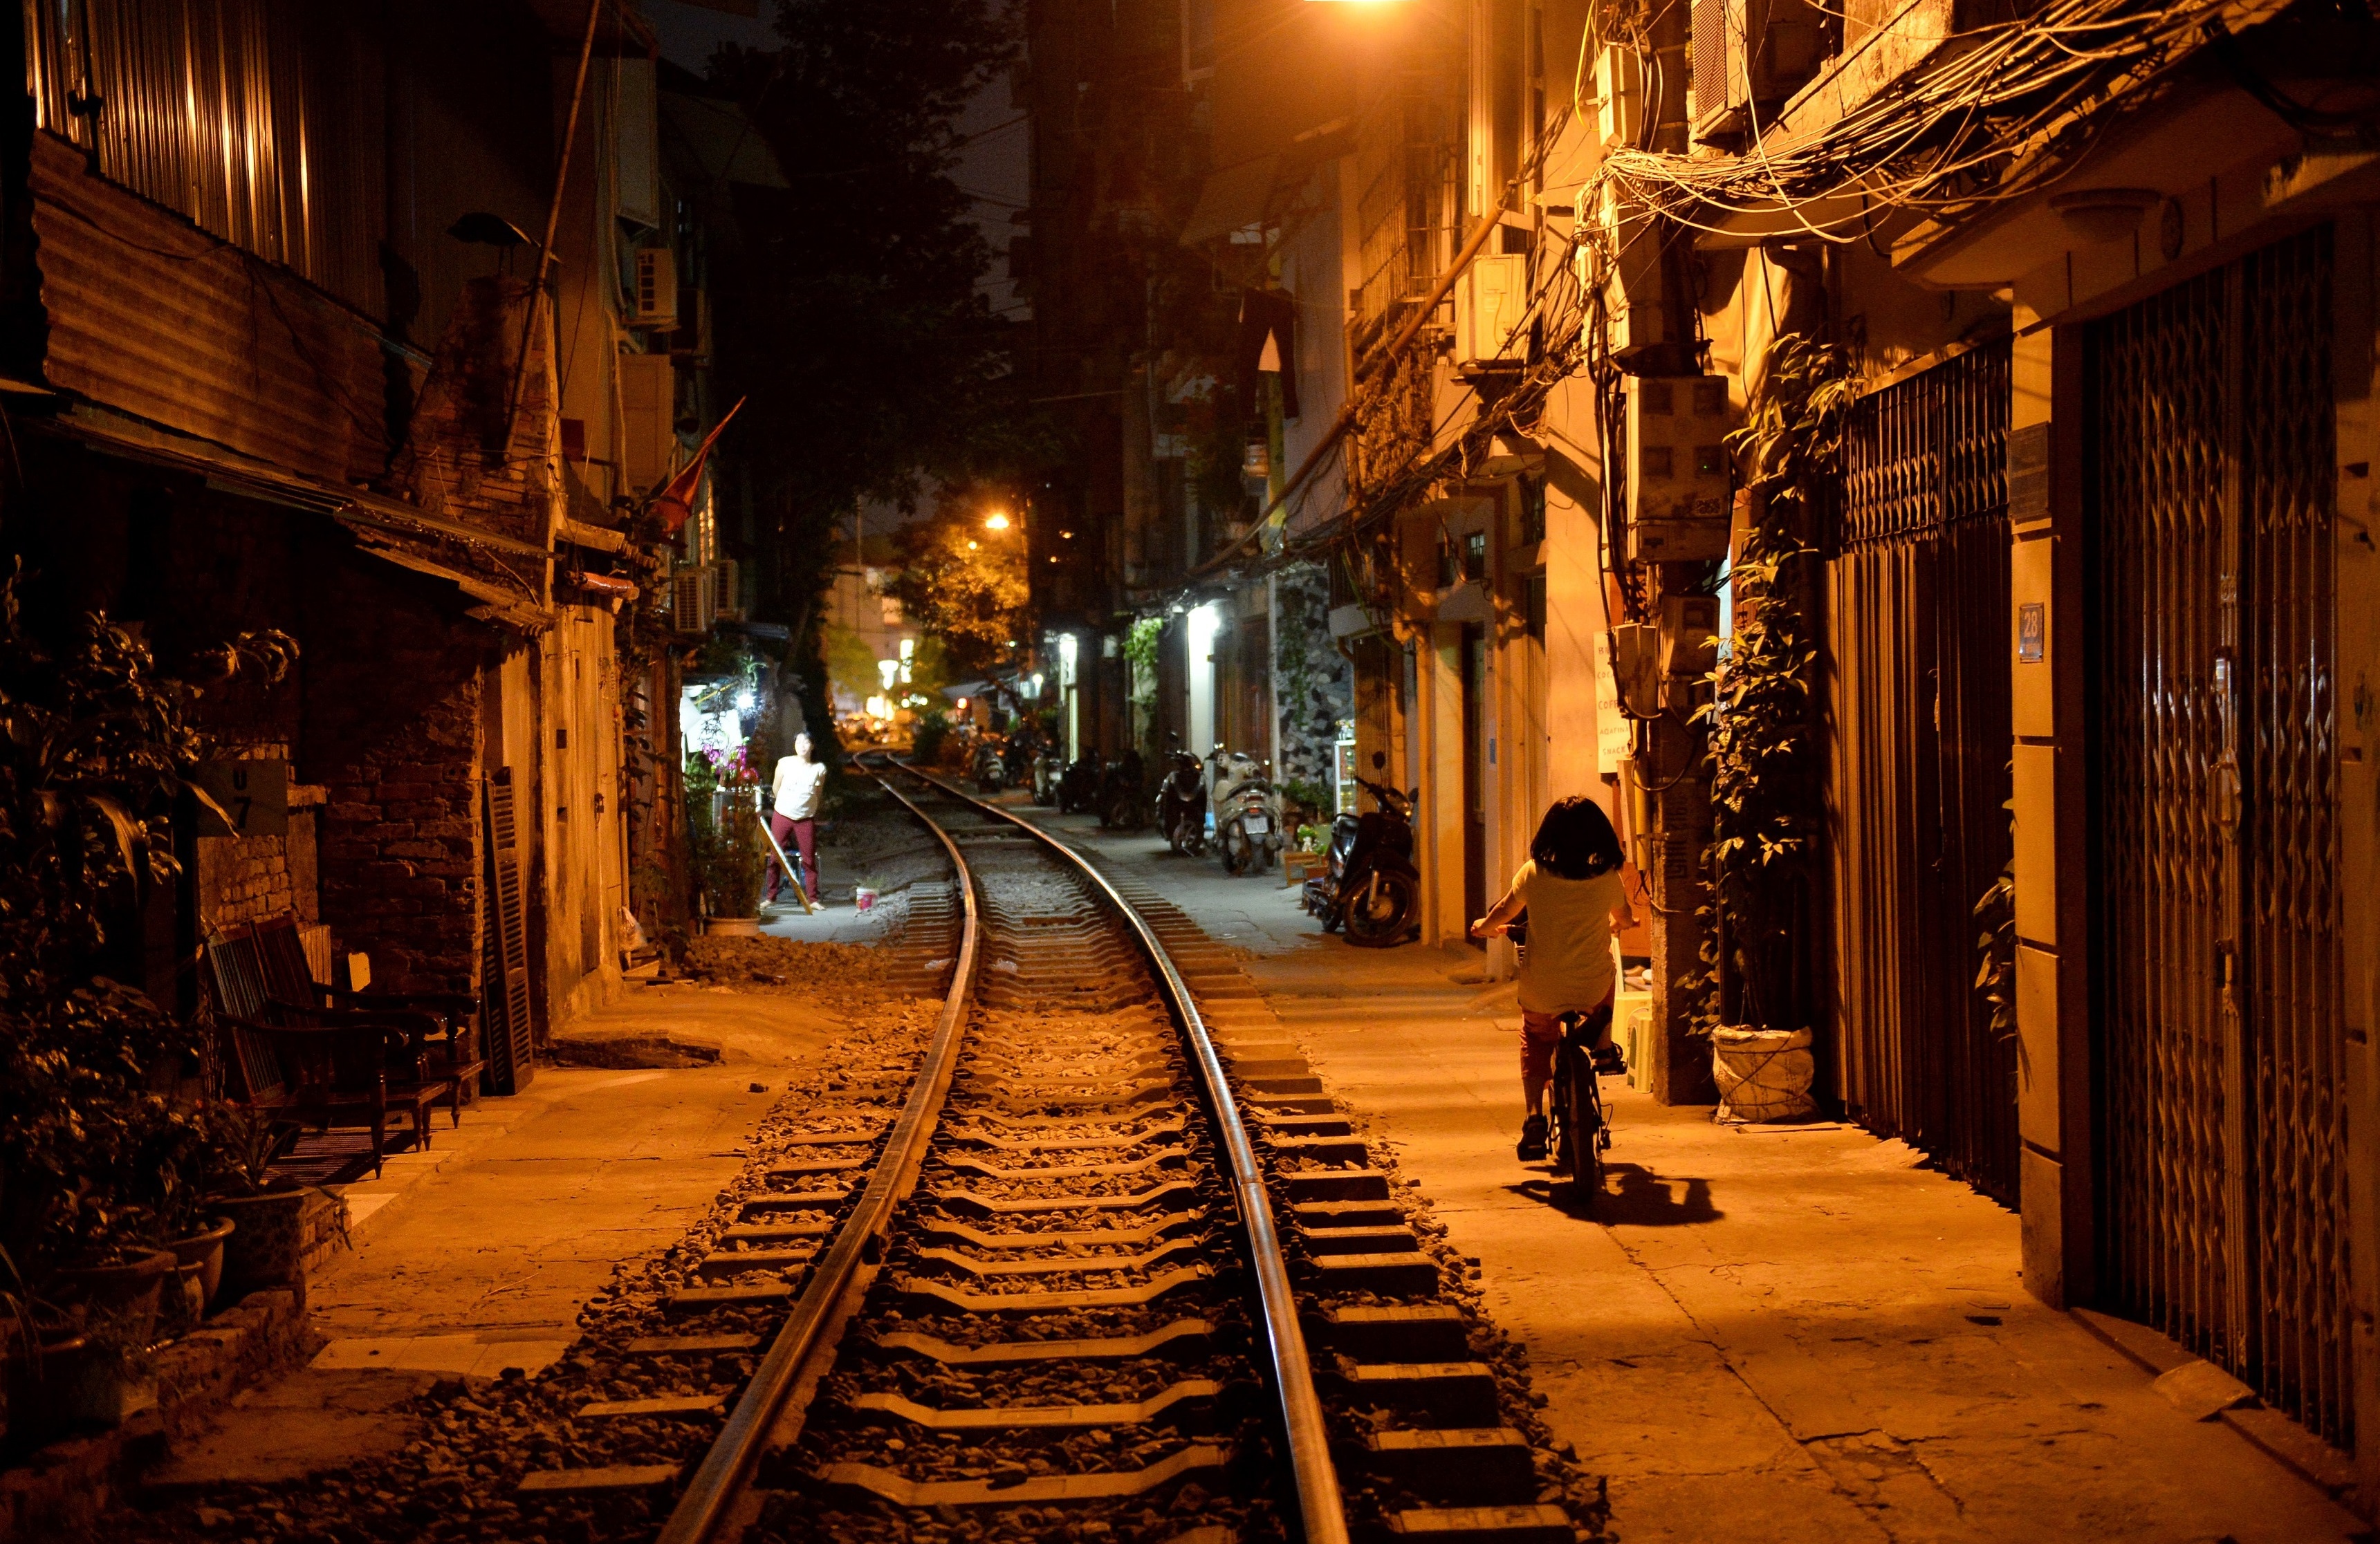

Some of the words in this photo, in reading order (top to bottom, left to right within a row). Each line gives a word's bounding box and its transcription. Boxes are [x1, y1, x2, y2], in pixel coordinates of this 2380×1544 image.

[2024, 611, 2038, 638] 28
[1598, 700, 1618, 710] COFF
[1603, 746, 1626, 756] SNACK
[234, 797, 251, 829] 7
